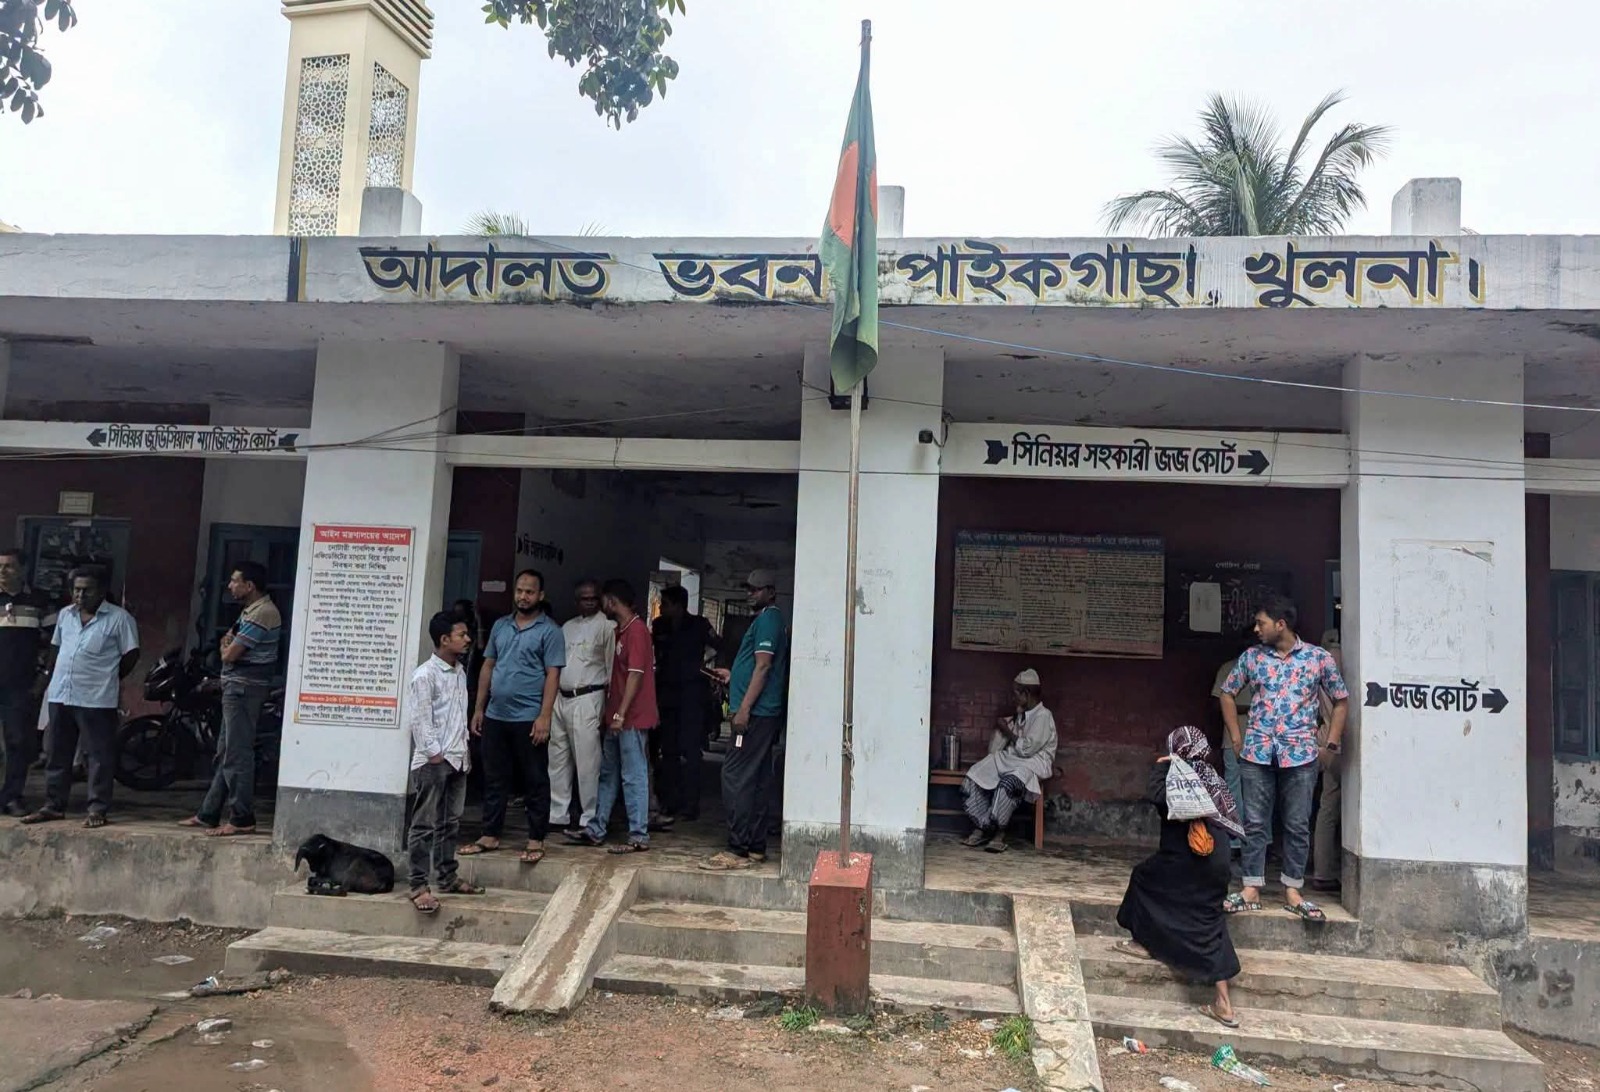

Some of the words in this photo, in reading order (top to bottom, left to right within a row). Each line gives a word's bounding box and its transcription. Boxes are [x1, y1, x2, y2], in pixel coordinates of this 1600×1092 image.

[360, 242, 613, 302] আদালত
[653, 246, 822, 305] ভবন
[108, 424, 142, 448] সিনিয়র
[250, 427, 278, 450] কোর্ট
[1012, 431, 1081, 469] সিনিয়র
[1083, 438, 1151, 471] সহকারী
[1154, 446, 1190, 473] জজ
[1192, 440, 1238, 474] কোর্ট
[319, 529, 340, 538] আইন
[1389, 682, 1430, 710] জজ
[1431, 678, 1480, 712] কোর্ট
